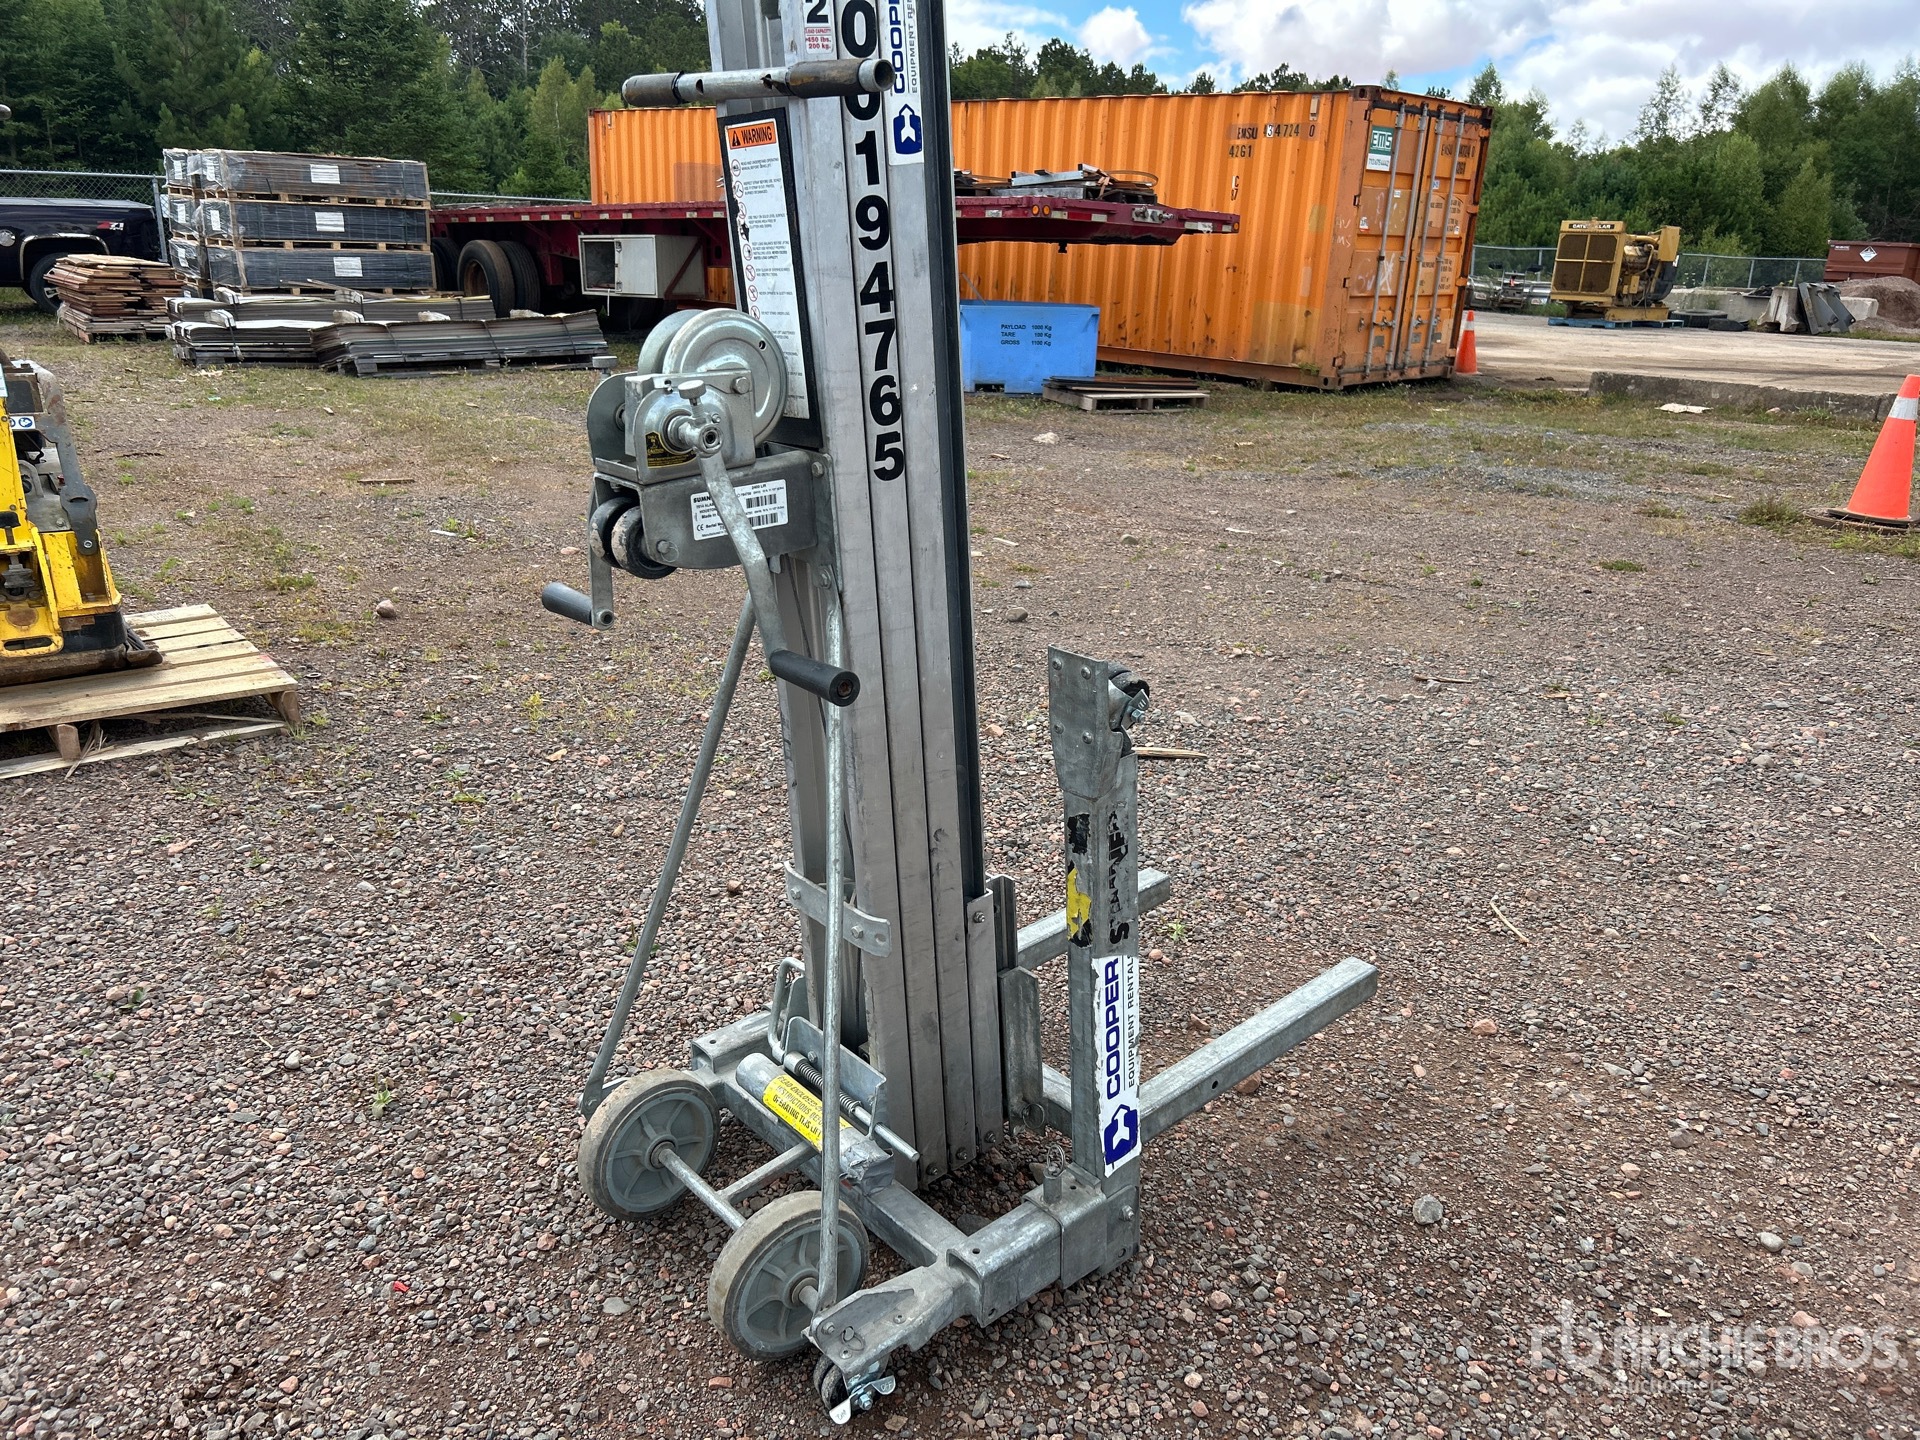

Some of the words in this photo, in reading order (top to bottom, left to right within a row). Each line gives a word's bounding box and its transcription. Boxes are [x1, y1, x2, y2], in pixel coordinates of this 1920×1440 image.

[907, 0, 916, 18] RE
[888, 0, 905, 94] COOP
[908, 25, 918, 93] EQUIPMENT
[741, 126, 773, 144] WARNING
[1237, 127, 1258, 140] EMSU
[1371, 130, 1393, 149] EMS
[1105, 957, 1121, 1100] COOPER
[1127, 1013, 1135, 1088] EQUIPMENT
[772, 1094, 799, 1119] OPERATING
[799, 1114, 812, 1130] THIS
[776, 1086, 810, 1115] INSTRUCTIONS
